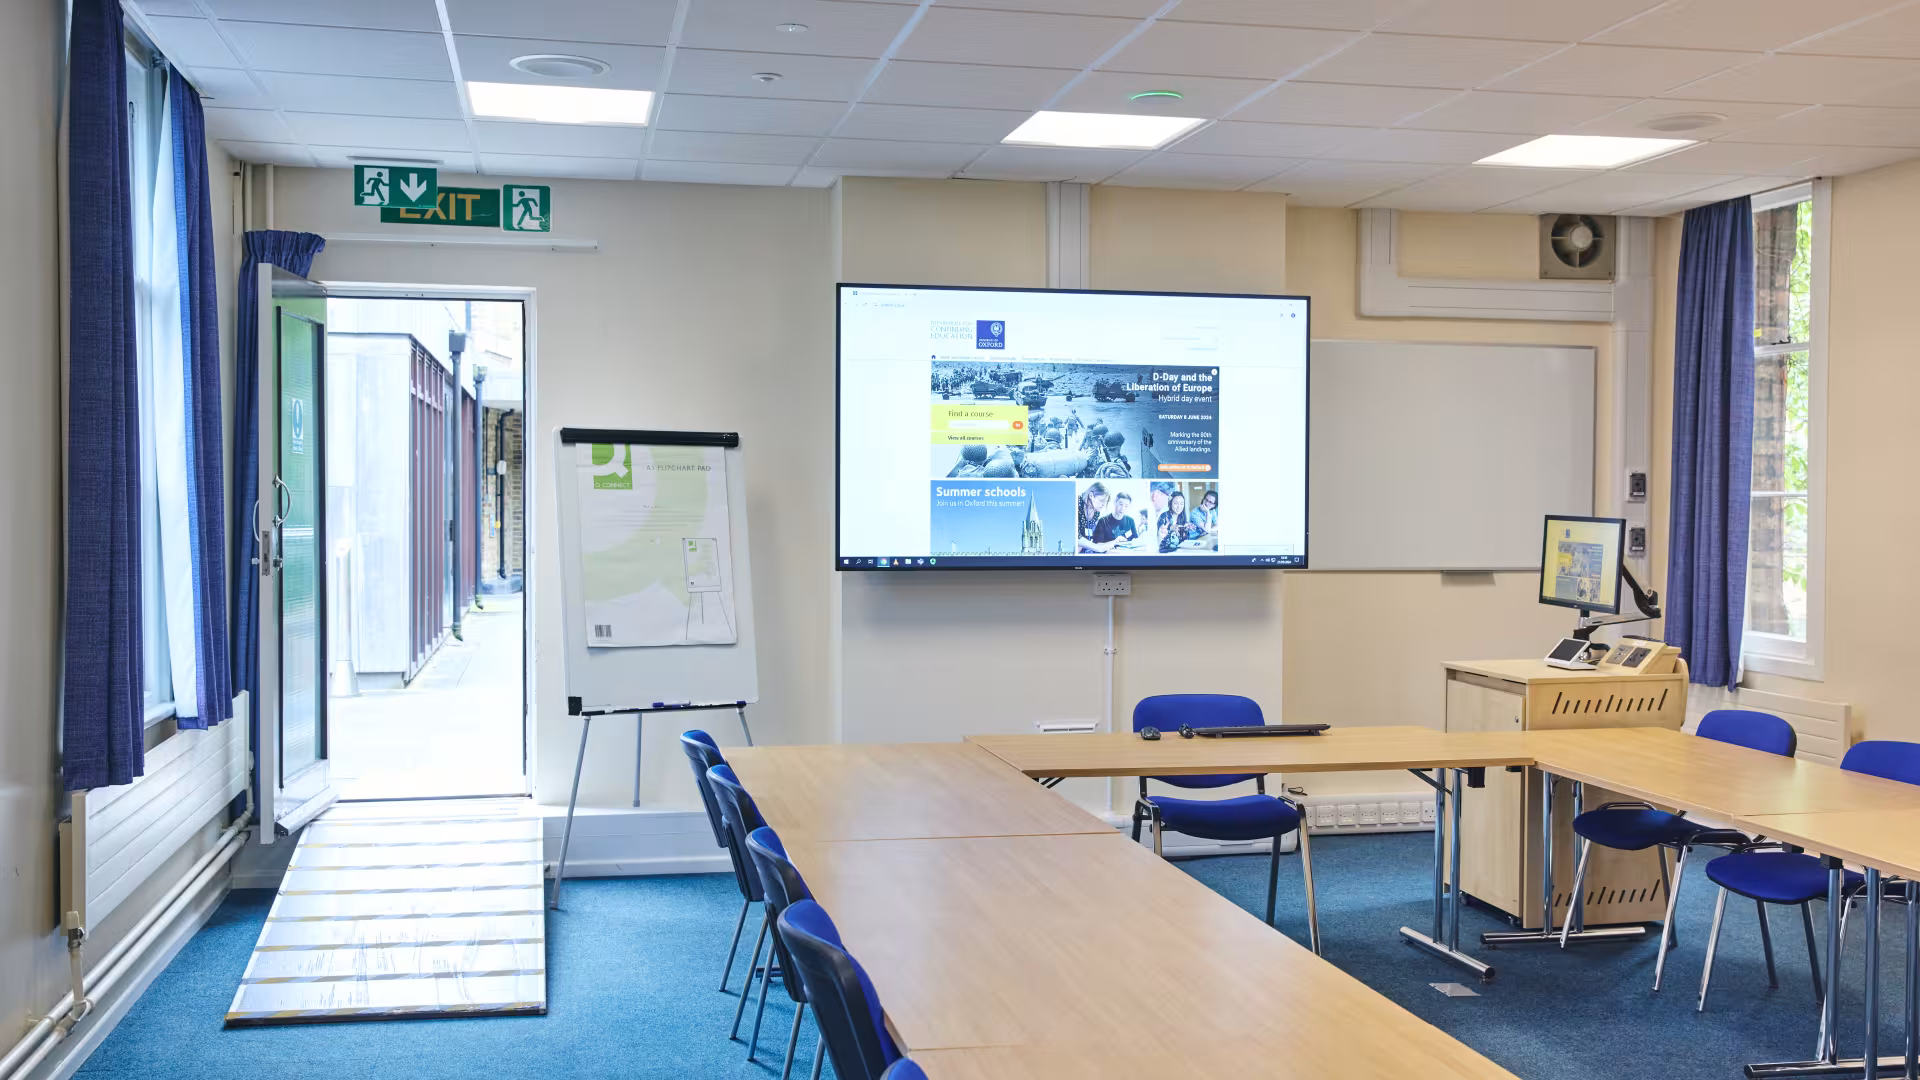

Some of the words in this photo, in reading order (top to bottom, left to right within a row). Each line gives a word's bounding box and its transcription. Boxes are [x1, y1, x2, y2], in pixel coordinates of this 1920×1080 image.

[1153, 373, 1178, 382] D-Day
[1181, 373, 1197, 382] and
[1199, 373, 1213, 382] the
[1126, 383, 1170, 391] Liberation
[1172, 384, 1181, 392] of
[1183, 384, 1213, 394] Europe
[1158, 395, 1180, 403] Hybrid
[936, 486, 982, 496] Summer
[984, 486, 1026, 497] schools
